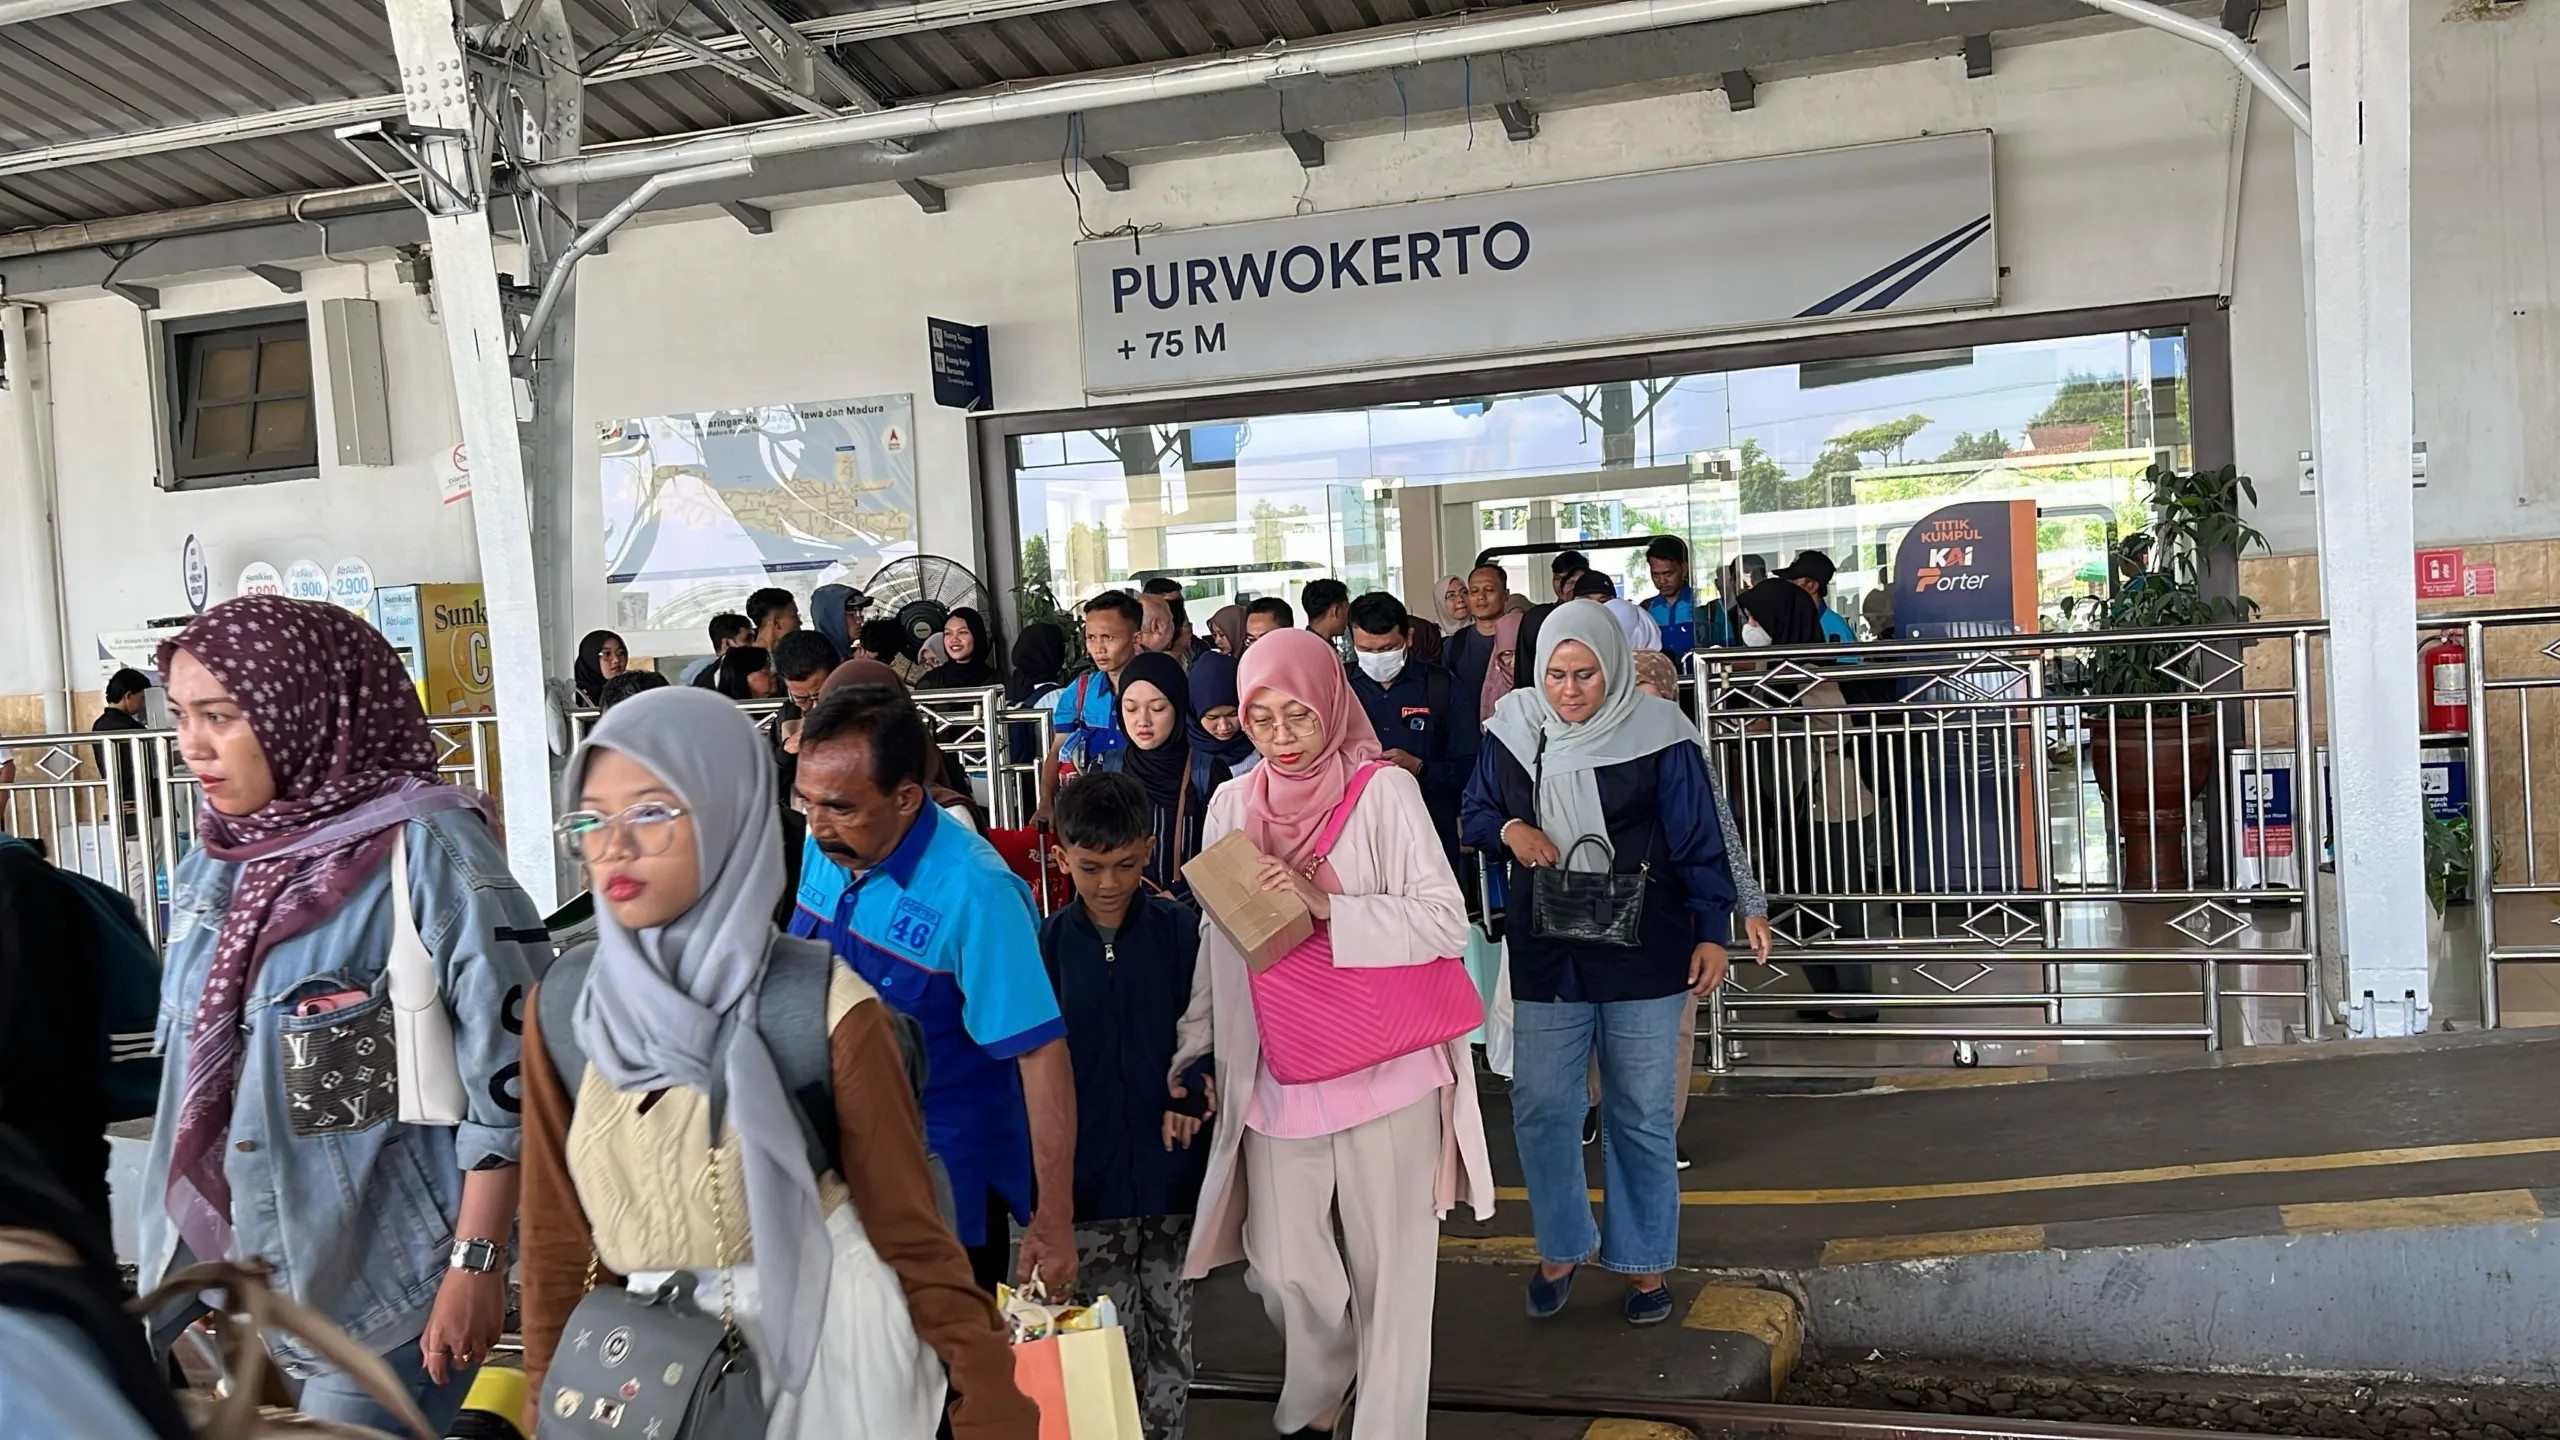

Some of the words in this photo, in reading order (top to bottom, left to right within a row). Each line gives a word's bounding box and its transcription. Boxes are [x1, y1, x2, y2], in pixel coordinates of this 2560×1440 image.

[1112, 220, 1530, 314] PURWOKERTO
[1118, 339, 1136, 360] +
[1146, 329, 1184, 359] 75
[1195, 322, 1227, 354] M
[706, 416, 743, 429] aringan
[825, 408, 844, 418] dan
[846, 404, 884, 416] Madura
[1921, 529, 1983, 543] KUMPUL
[1932, 519, 1970, 531] TITIK
[1915, 567, 1990, 593] Porter
[385, 595, 413, 605] Sunkist
[434, 599, 488, 631] Sunk
[468, 631, 490, 685] C
[893, 915, 931, 949] 46
